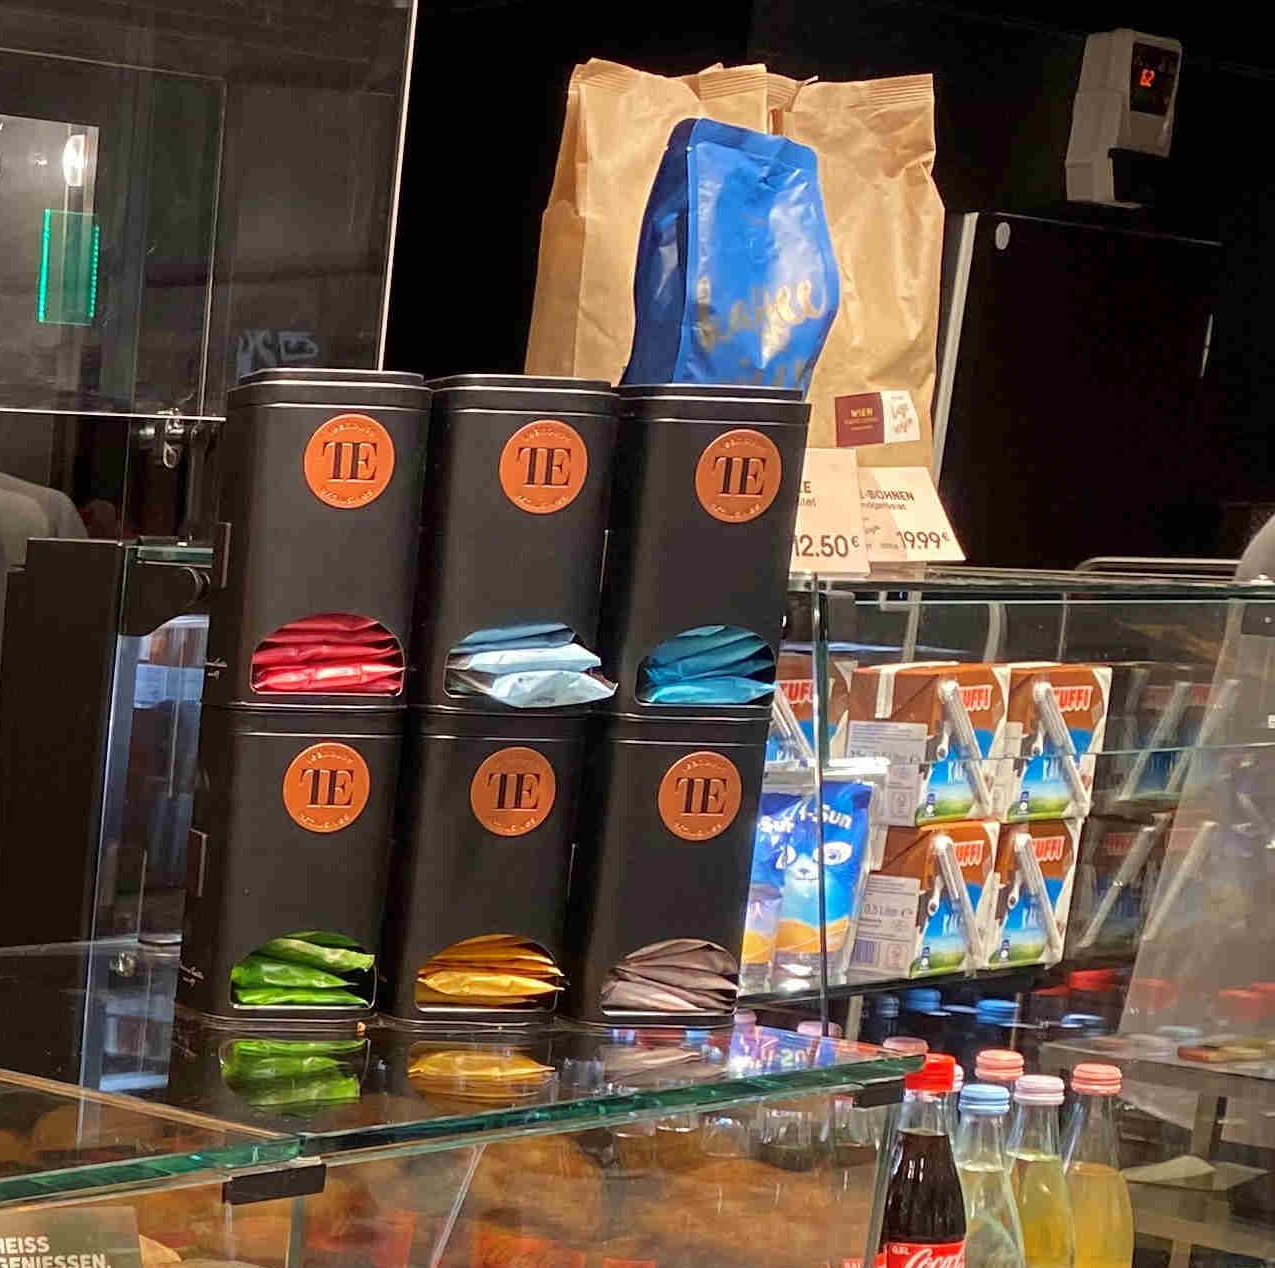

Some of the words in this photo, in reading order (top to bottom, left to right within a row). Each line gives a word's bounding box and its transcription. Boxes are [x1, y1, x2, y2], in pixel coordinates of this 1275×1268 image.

[322, 440, 378, 483] TE
[517, 447, 572, 489] TE
[714, 456, 767, 498] TE
[958, 685, 992, 711] UFFI
[300, 768, 355, 809] TE
[489, 772, 542, 813] TE
[674, 776, 728, 818] TE
[955, 840, 984, 865] UFFI
[1033, 836, 1065, 861] UFFI
